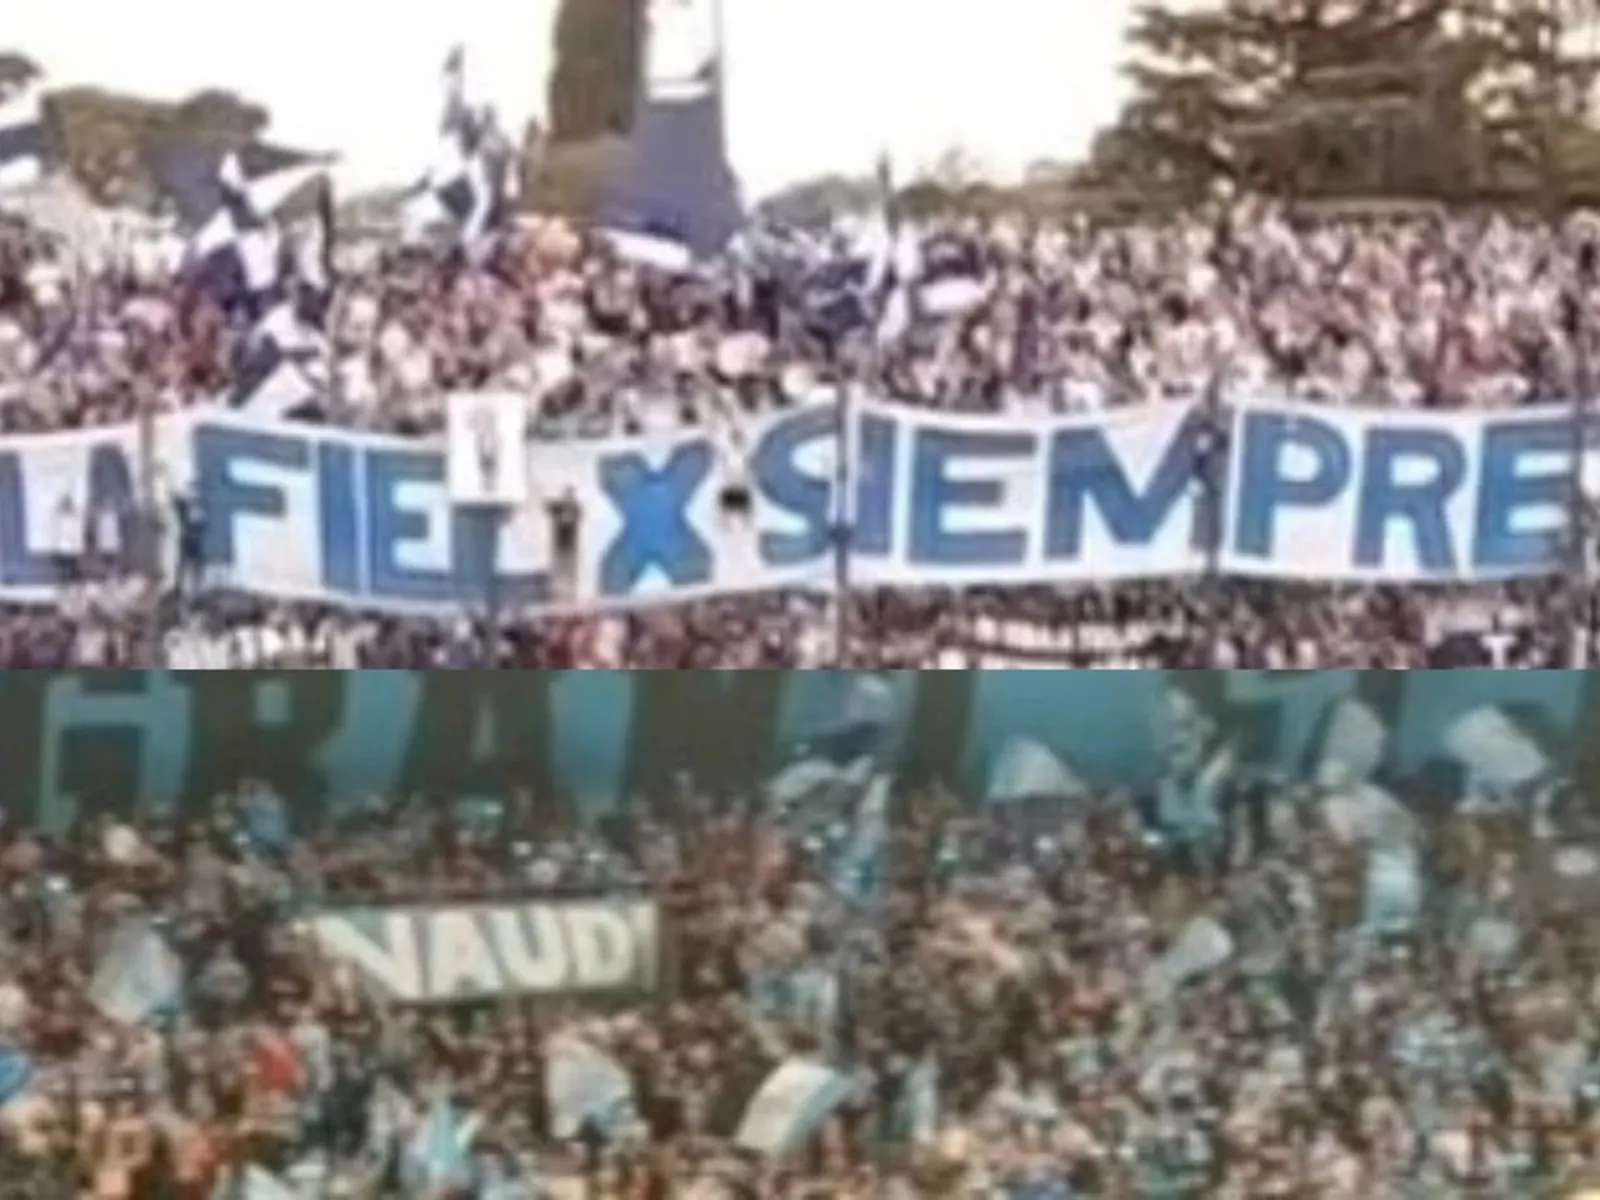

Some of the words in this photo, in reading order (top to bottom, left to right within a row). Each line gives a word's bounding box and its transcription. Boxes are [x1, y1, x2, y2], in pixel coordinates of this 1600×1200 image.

[193, 423, 548, 601] FIEL
[598, 439, 713, 593] X
[748, 403, 1578, 570] SIEMPRE
